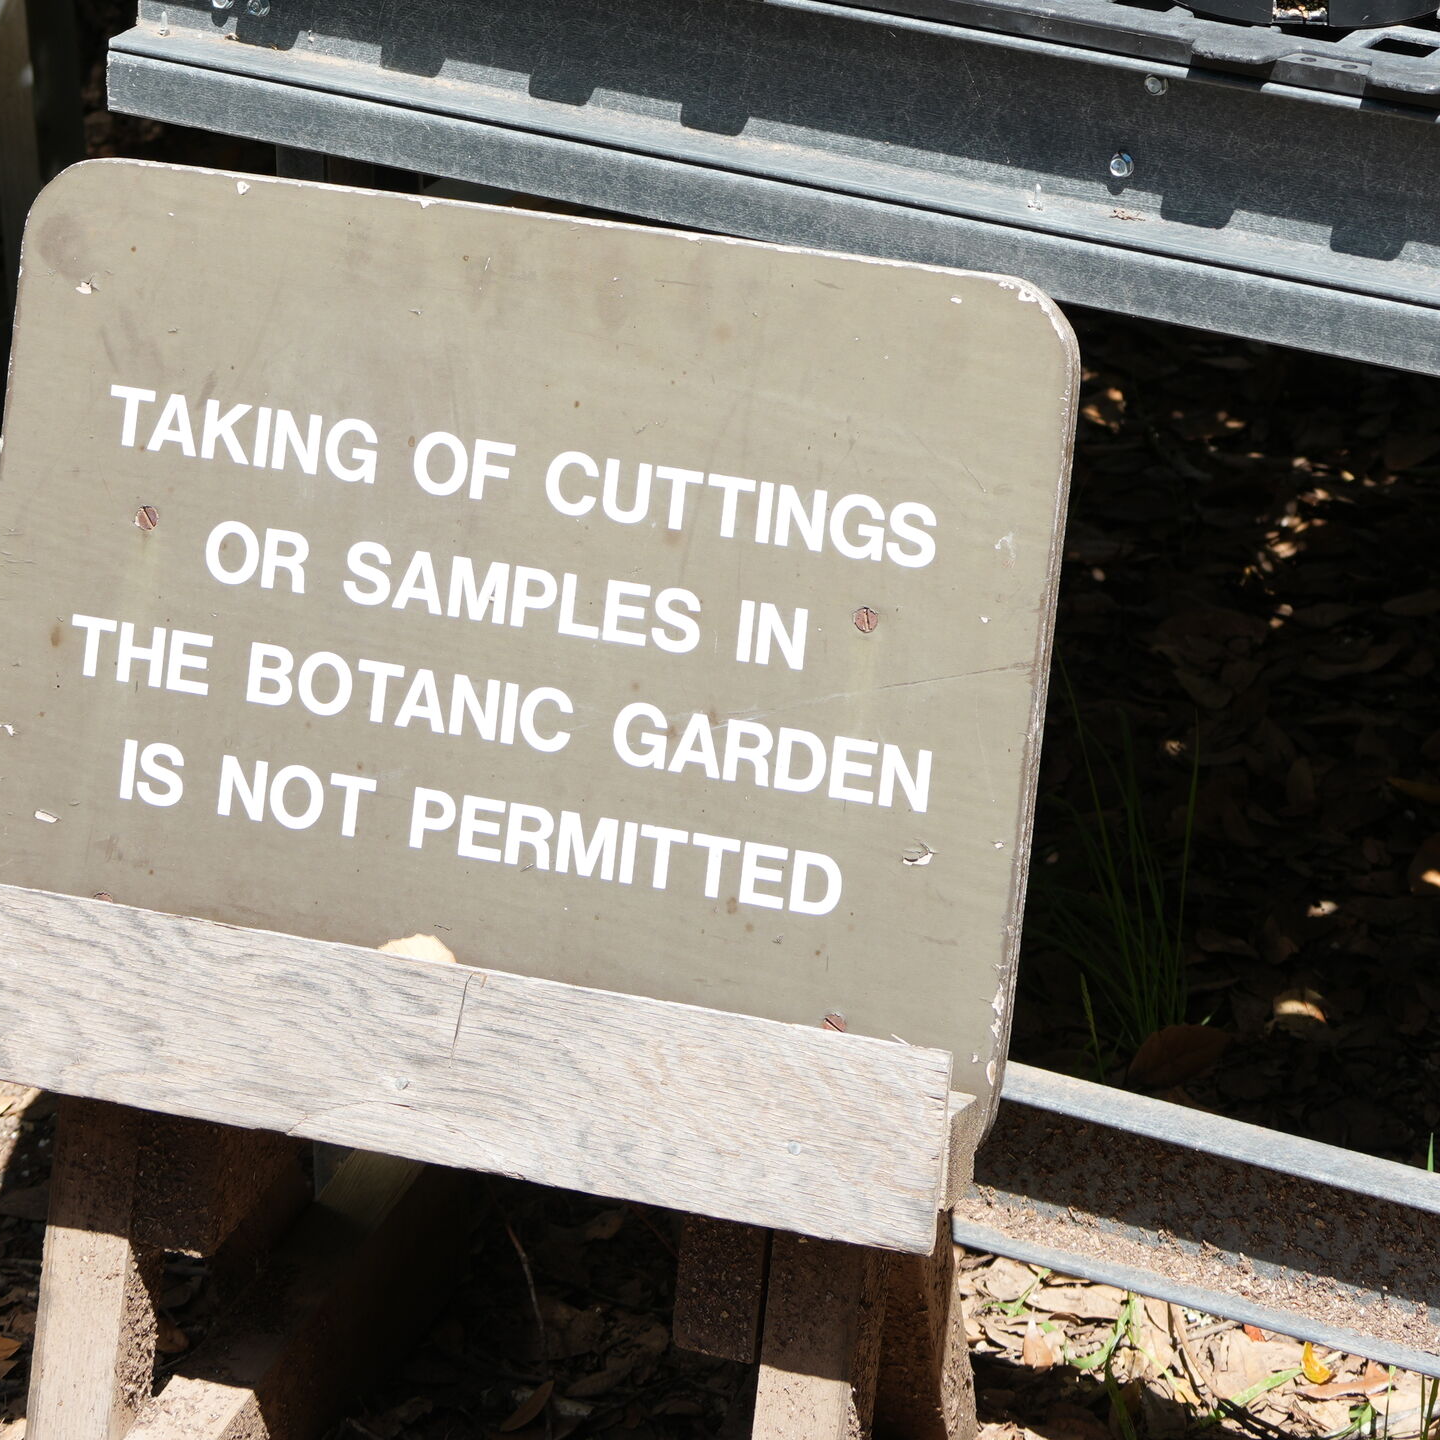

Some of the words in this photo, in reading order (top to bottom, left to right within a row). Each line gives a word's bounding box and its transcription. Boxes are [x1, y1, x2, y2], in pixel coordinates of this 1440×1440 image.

[111, 385, 378, 484] TAKING
[414, 431, 516, 500] OF
[546, 451, 937, 568] CUTTINGS
[206, 521, 309, 593] OR
[343, 541, 701, 653] SAMPLES
[736, 600, 808, 670] IN
[72, 614, 213, 695] THE
[246, 642, 573, 752] BOTANIC
[613, 702, 932, 812] GARDEN
[120, 739, 184, 806] IS
[218, 755, 377, 837] NOT
[409, 787, 842, 915] PERMITTED
